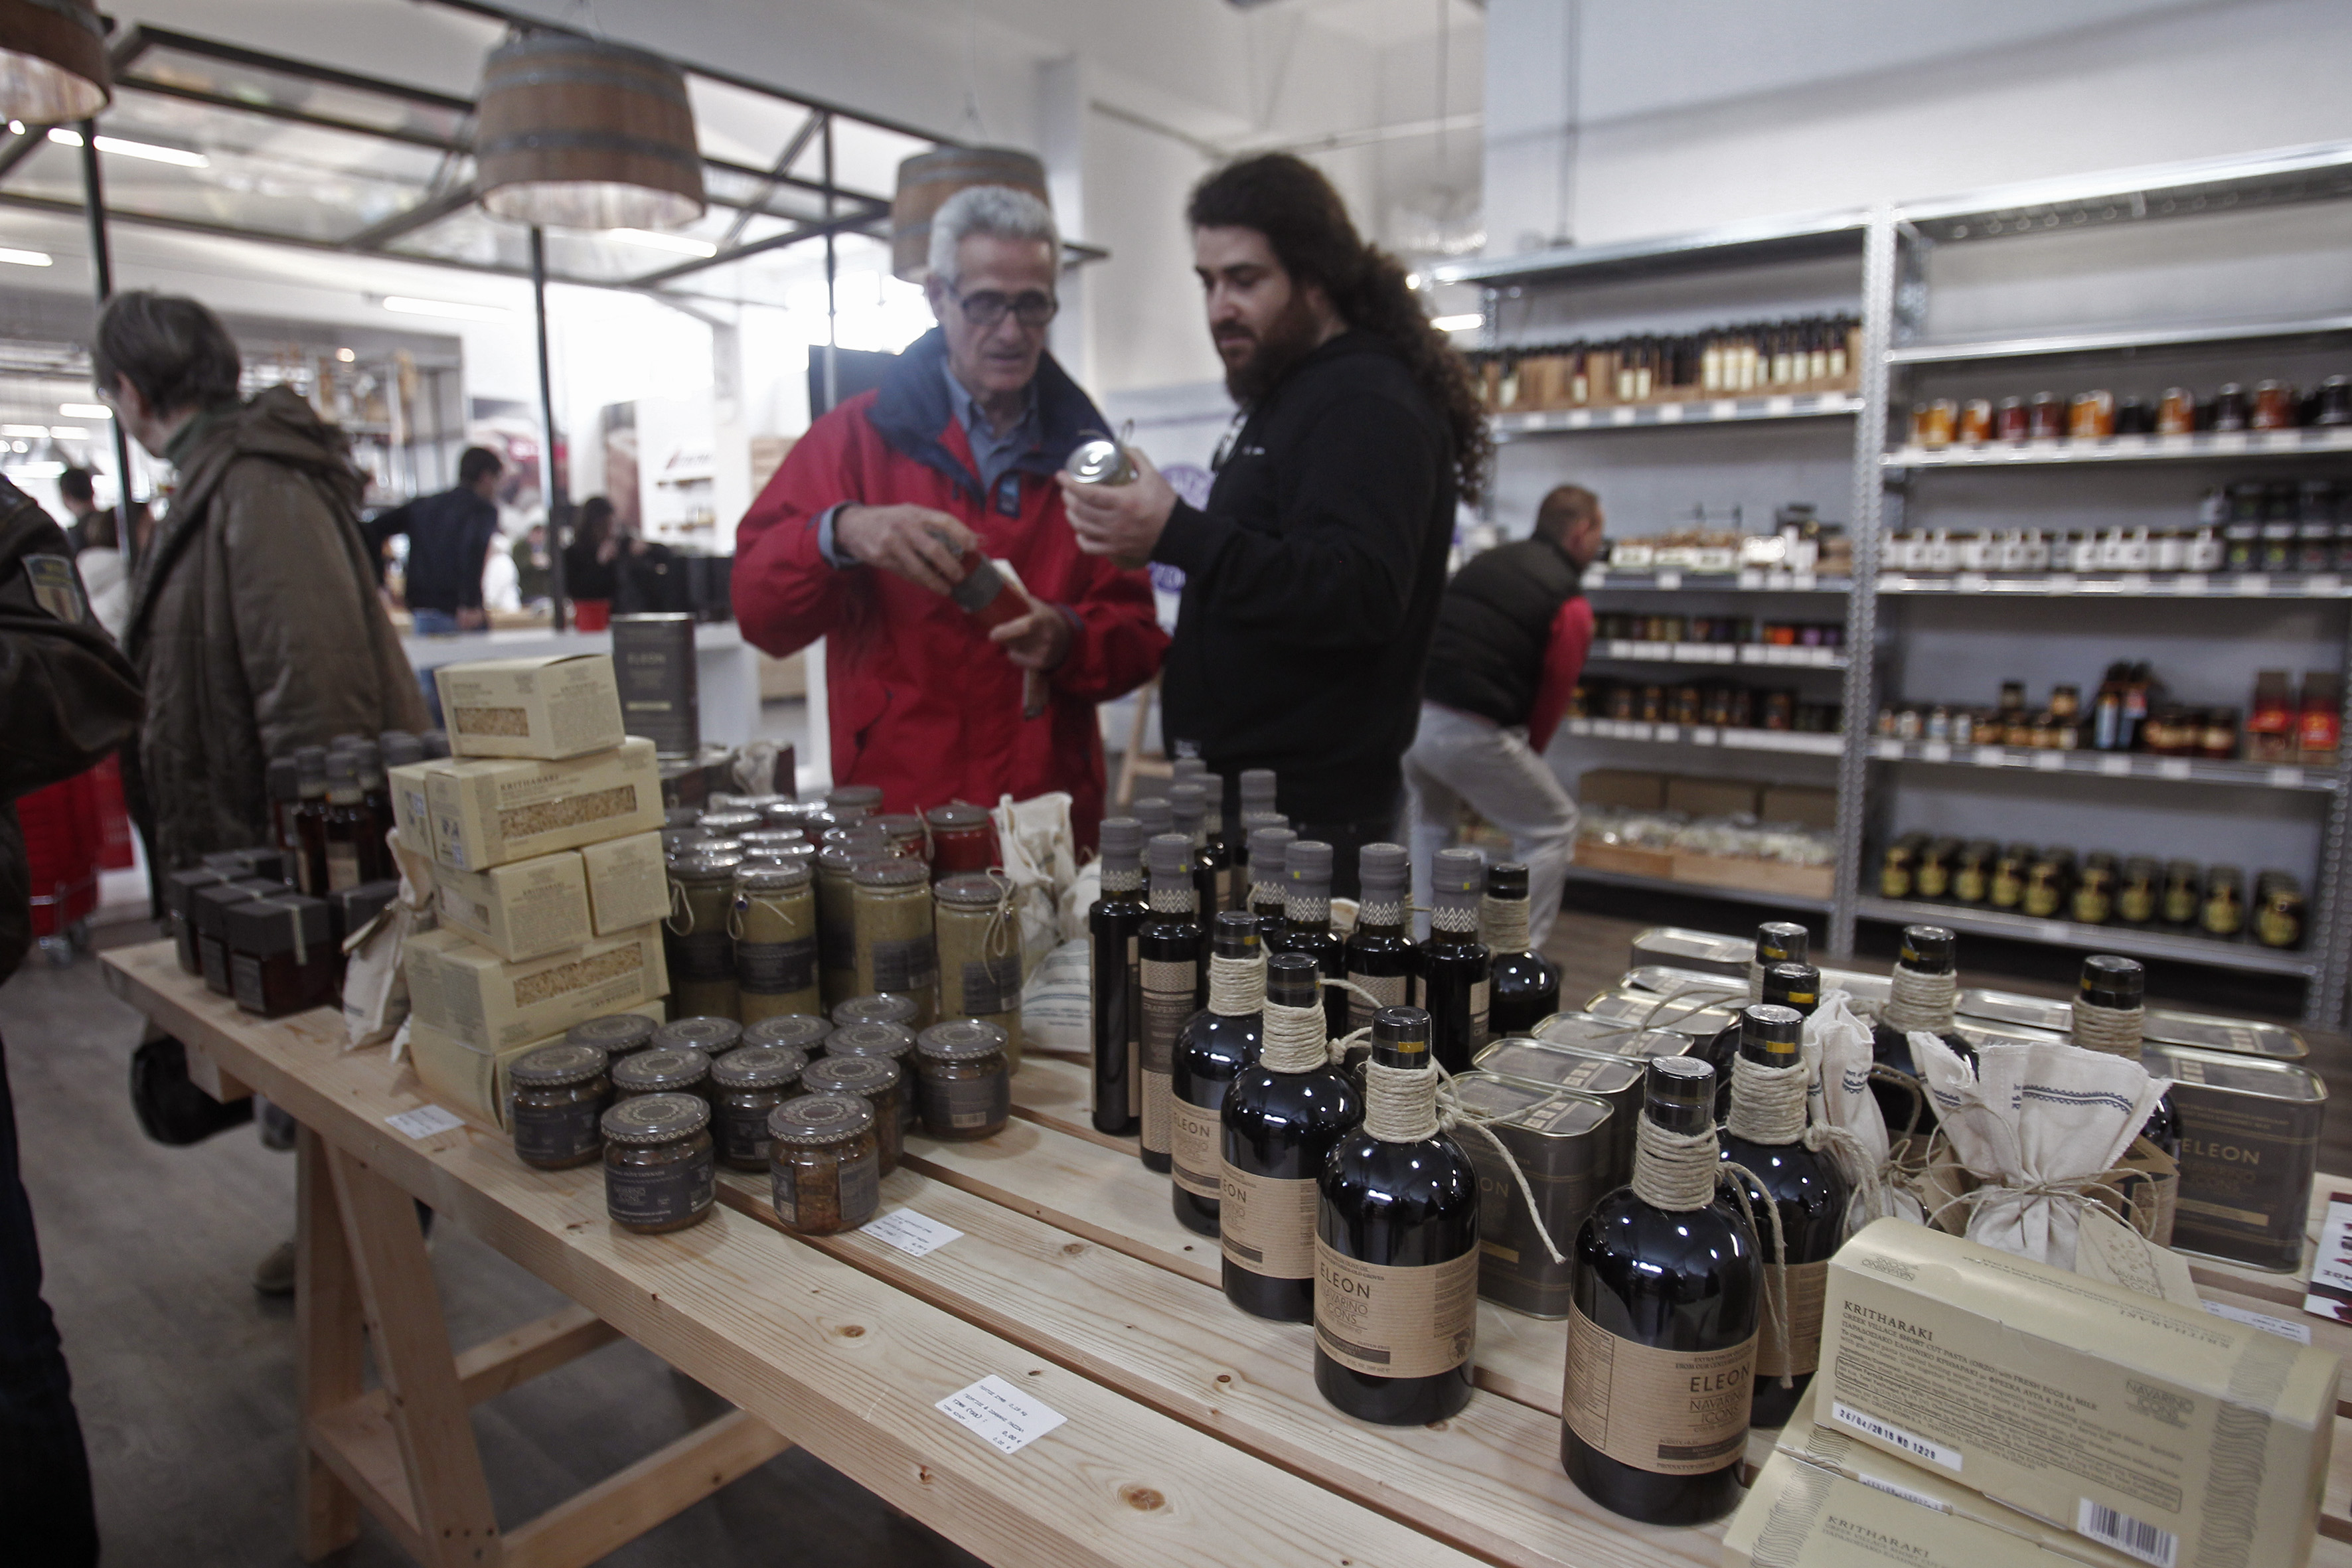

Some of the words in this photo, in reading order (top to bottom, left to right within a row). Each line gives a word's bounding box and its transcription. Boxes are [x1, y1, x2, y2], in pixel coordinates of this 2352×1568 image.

[2181, 1137, 2261, 1166] ELEON
[1320, 1263, 1370, 1299] ELEON
[1844, 1300, 1933, 1341] KRITHARAKI
[1689, 1362, 1751, 1392] ELEON
[1843, 1312, 1865, 1326] GREEK
[1867, 1321, 1897, 1337] VILLAGE
[1899, 1333, 1924, 1348] SHORT
[1926, 1343, 1942, 1354] CUT
[1943, 1349, 1968, 1364] PASTA
[2013, 1375, 2040, 1390] FRESH
[2042, 1385, 2064, 1399] EGGS
[2074, 1397, 2098, 1411] MILK
[1894, 1340, 1934, 1360] ΕΛΛΗΝΙΚΟ
[1988, 1375, 2021, 1393] ΦΡΕΣΚΑ
[2126, 1380, 2195, 1415] NAVARINO
[2137, 1397, 2179, 1420] ICONS
[1840, 1409, 1895, 1442] 26/04/2015
[1828, 1516, 1929, 1558] KRITHARAKI
